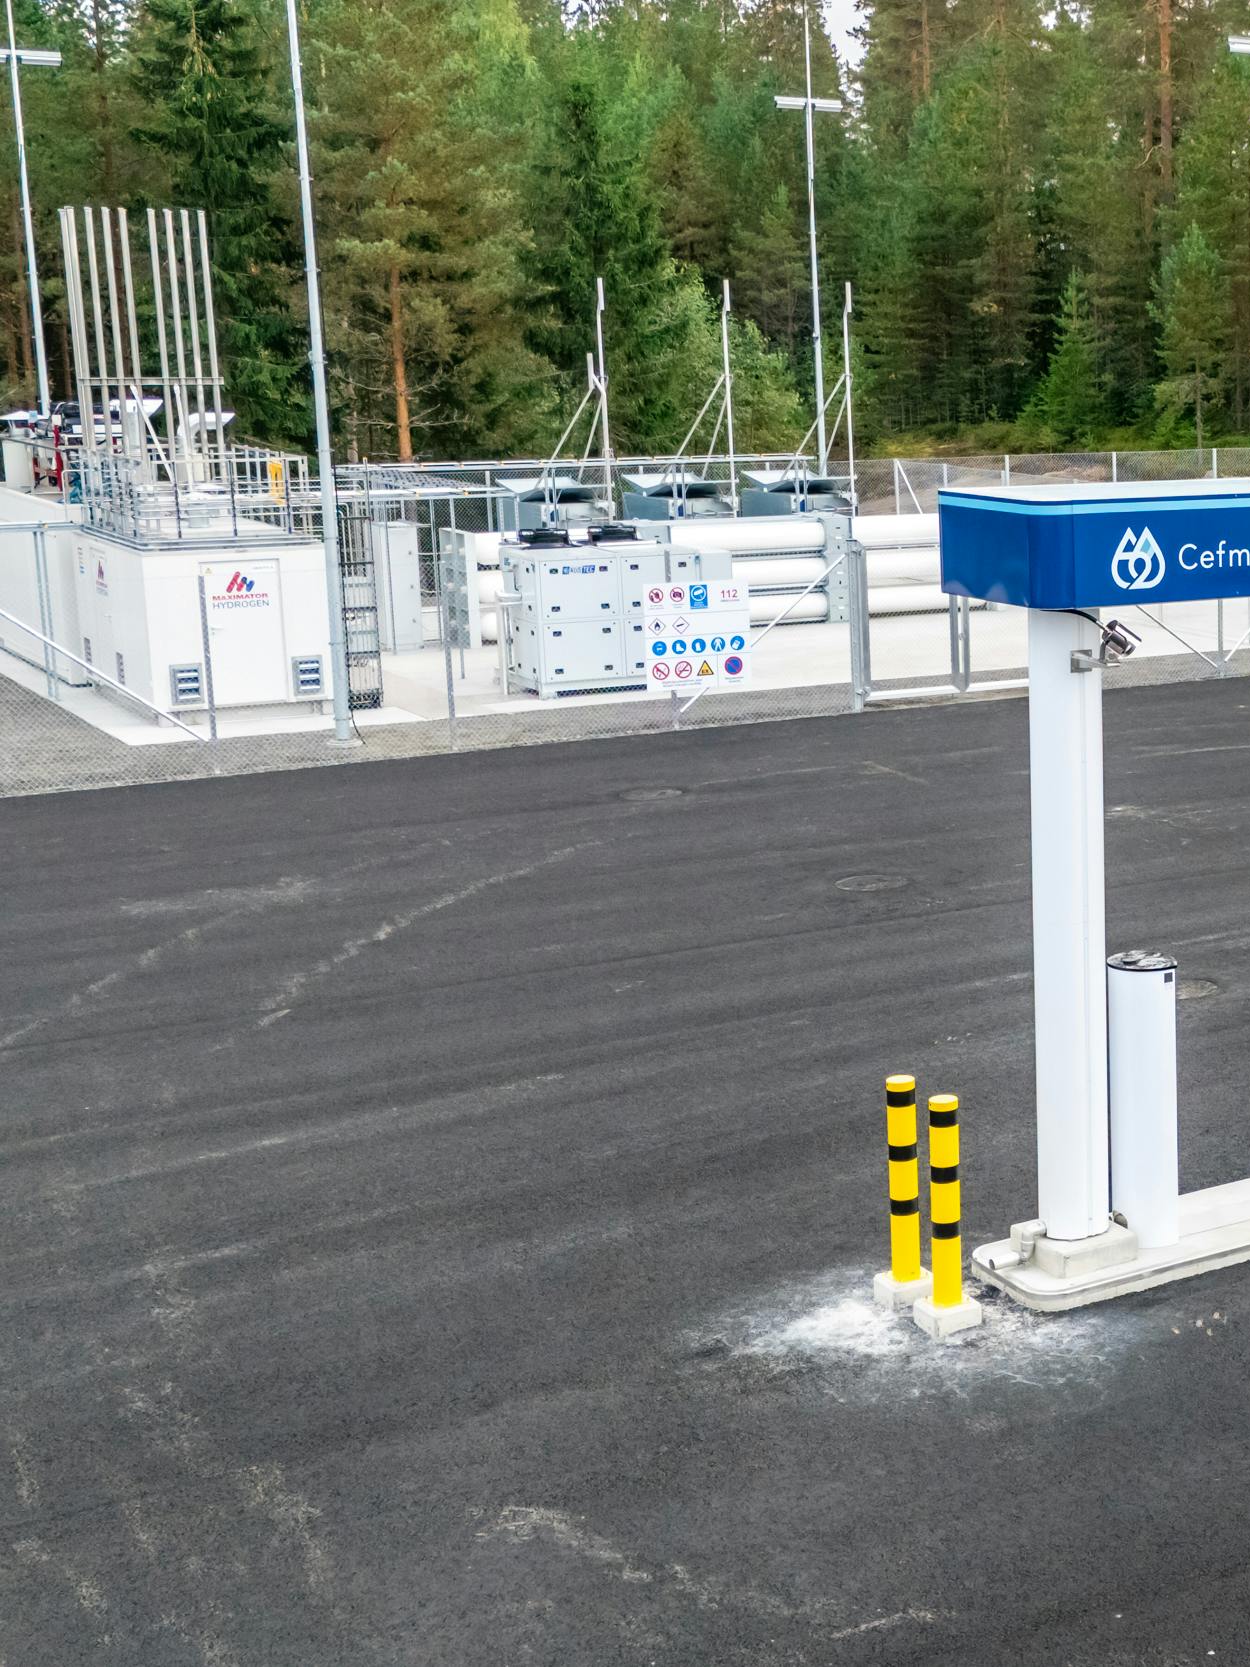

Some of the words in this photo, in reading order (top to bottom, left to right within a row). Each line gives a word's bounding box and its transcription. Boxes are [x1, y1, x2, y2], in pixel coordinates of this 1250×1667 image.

[212, 593, 268, 601] MAXIMATOR
[721, 589, 738, 599] 112
[213, 600, 270, 609] HYDROGEN
